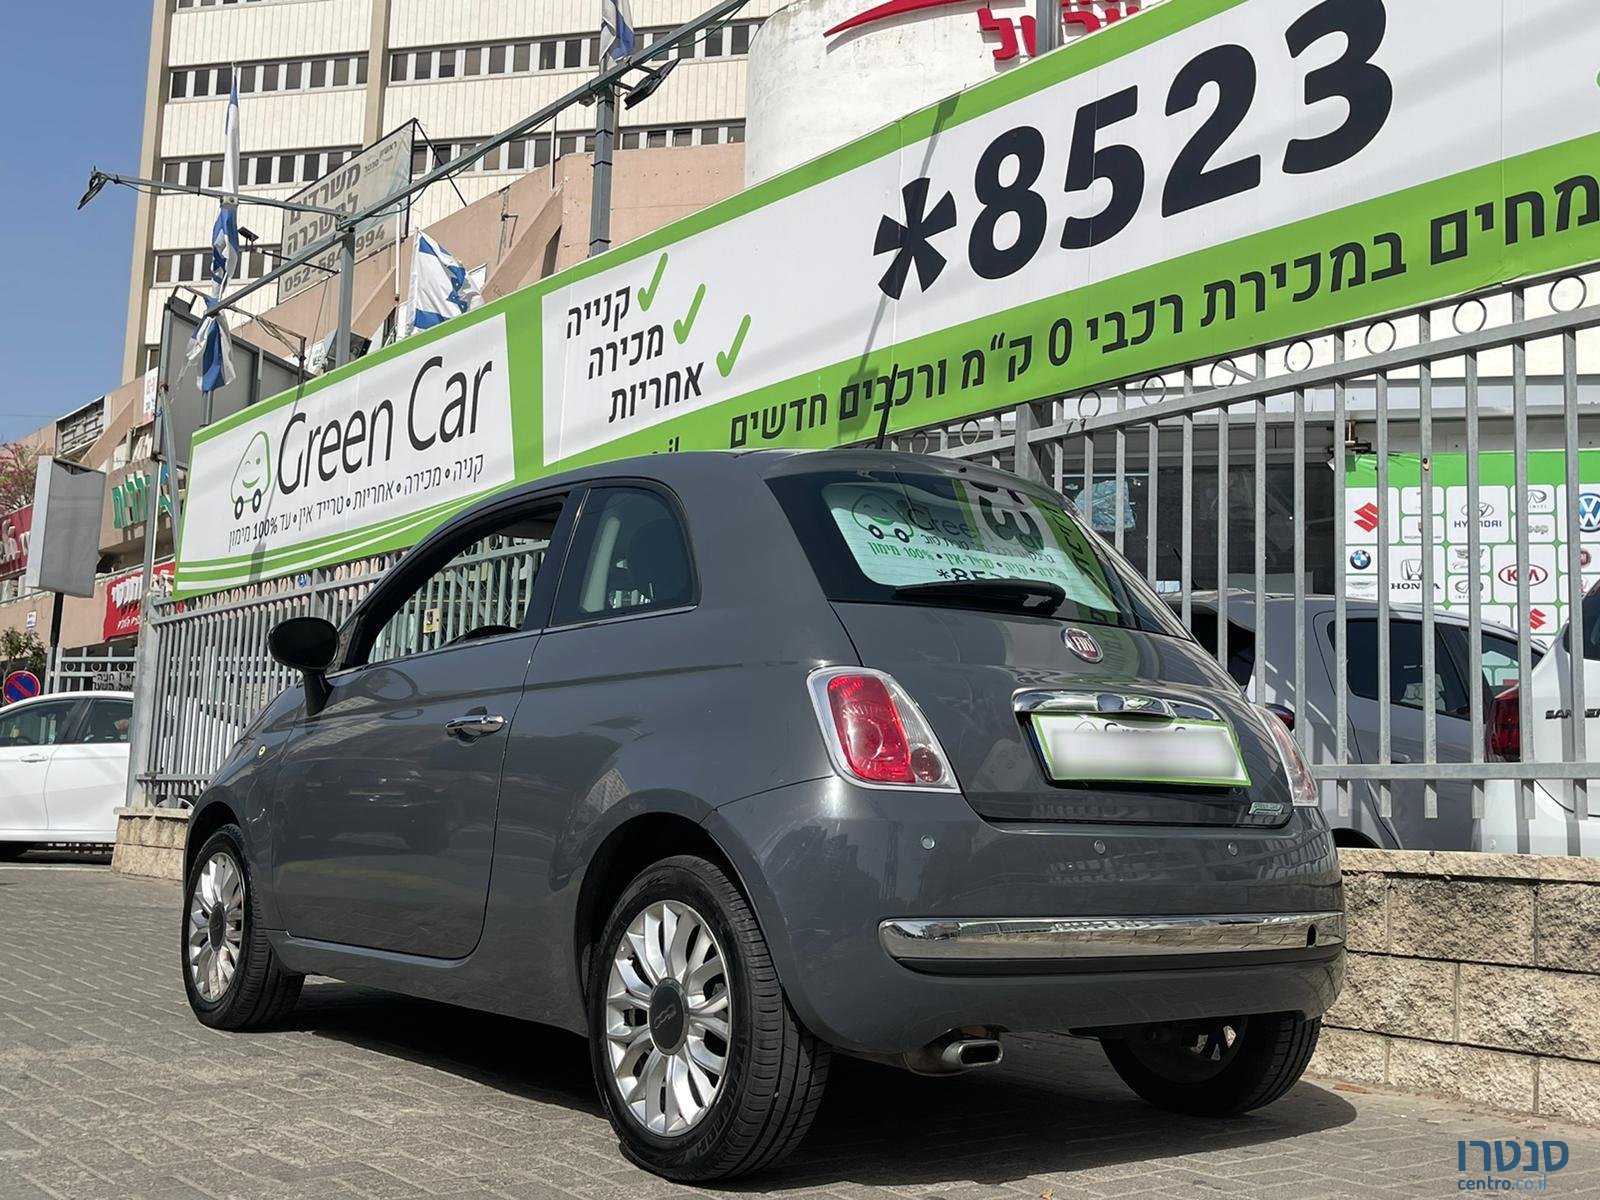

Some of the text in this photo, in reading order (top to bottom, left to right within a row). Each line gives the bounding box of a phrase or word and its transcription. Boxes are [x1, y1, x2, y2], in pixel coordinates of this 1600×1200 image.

[1200, 231, 1407, 327] במכירת
[567, 286, 631, 339] קנייה
[1048, 317, 1073, 366] 0
[1086, 294, 1183, 354] רכבי
[588, 324, 664, 380] מכירה
[609, 362, 704, 423] אחריות
[839, 358, 947, 420] ורכבים
[277, 356, 493, 495] Green Car
[730, 393, 827, 449] חדשים
[229, 454, 483, 552] קניה מכירה אחריות טרייד אין עד 100% מימון
[1507, 569, 1540, 582] KA
